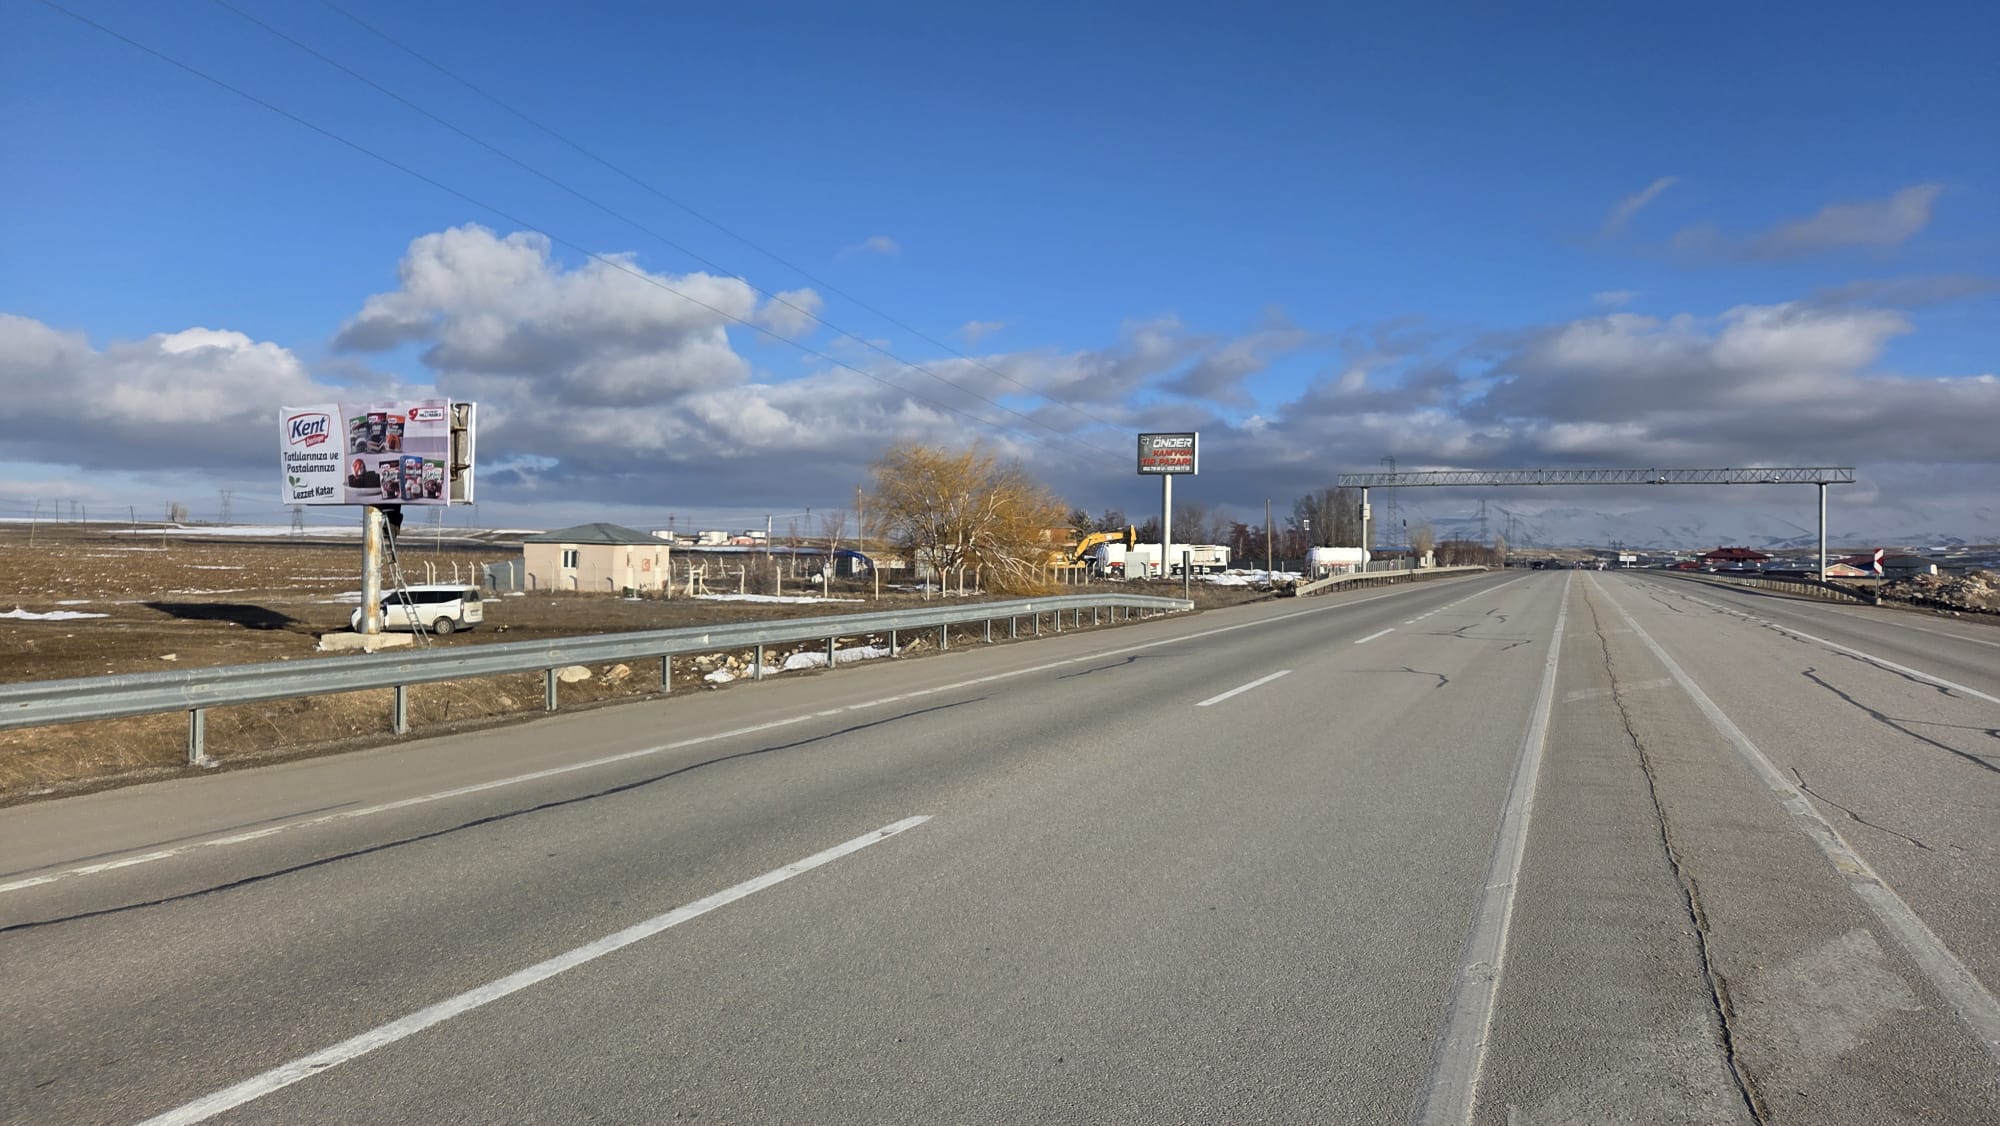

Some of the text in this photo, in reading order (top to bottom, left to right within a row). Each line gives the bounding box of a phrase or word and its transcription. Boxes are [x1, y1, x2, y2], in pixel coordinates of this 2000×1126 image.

[292, 416, 326, 439] Kent
[1152, 436, 1193, 448] ÖNDER
[330, 452, 339, 460] ve
[287, 463, 336, 473] Pastalarınıza
[293, 486, 334, 499] Lezzet Katar
